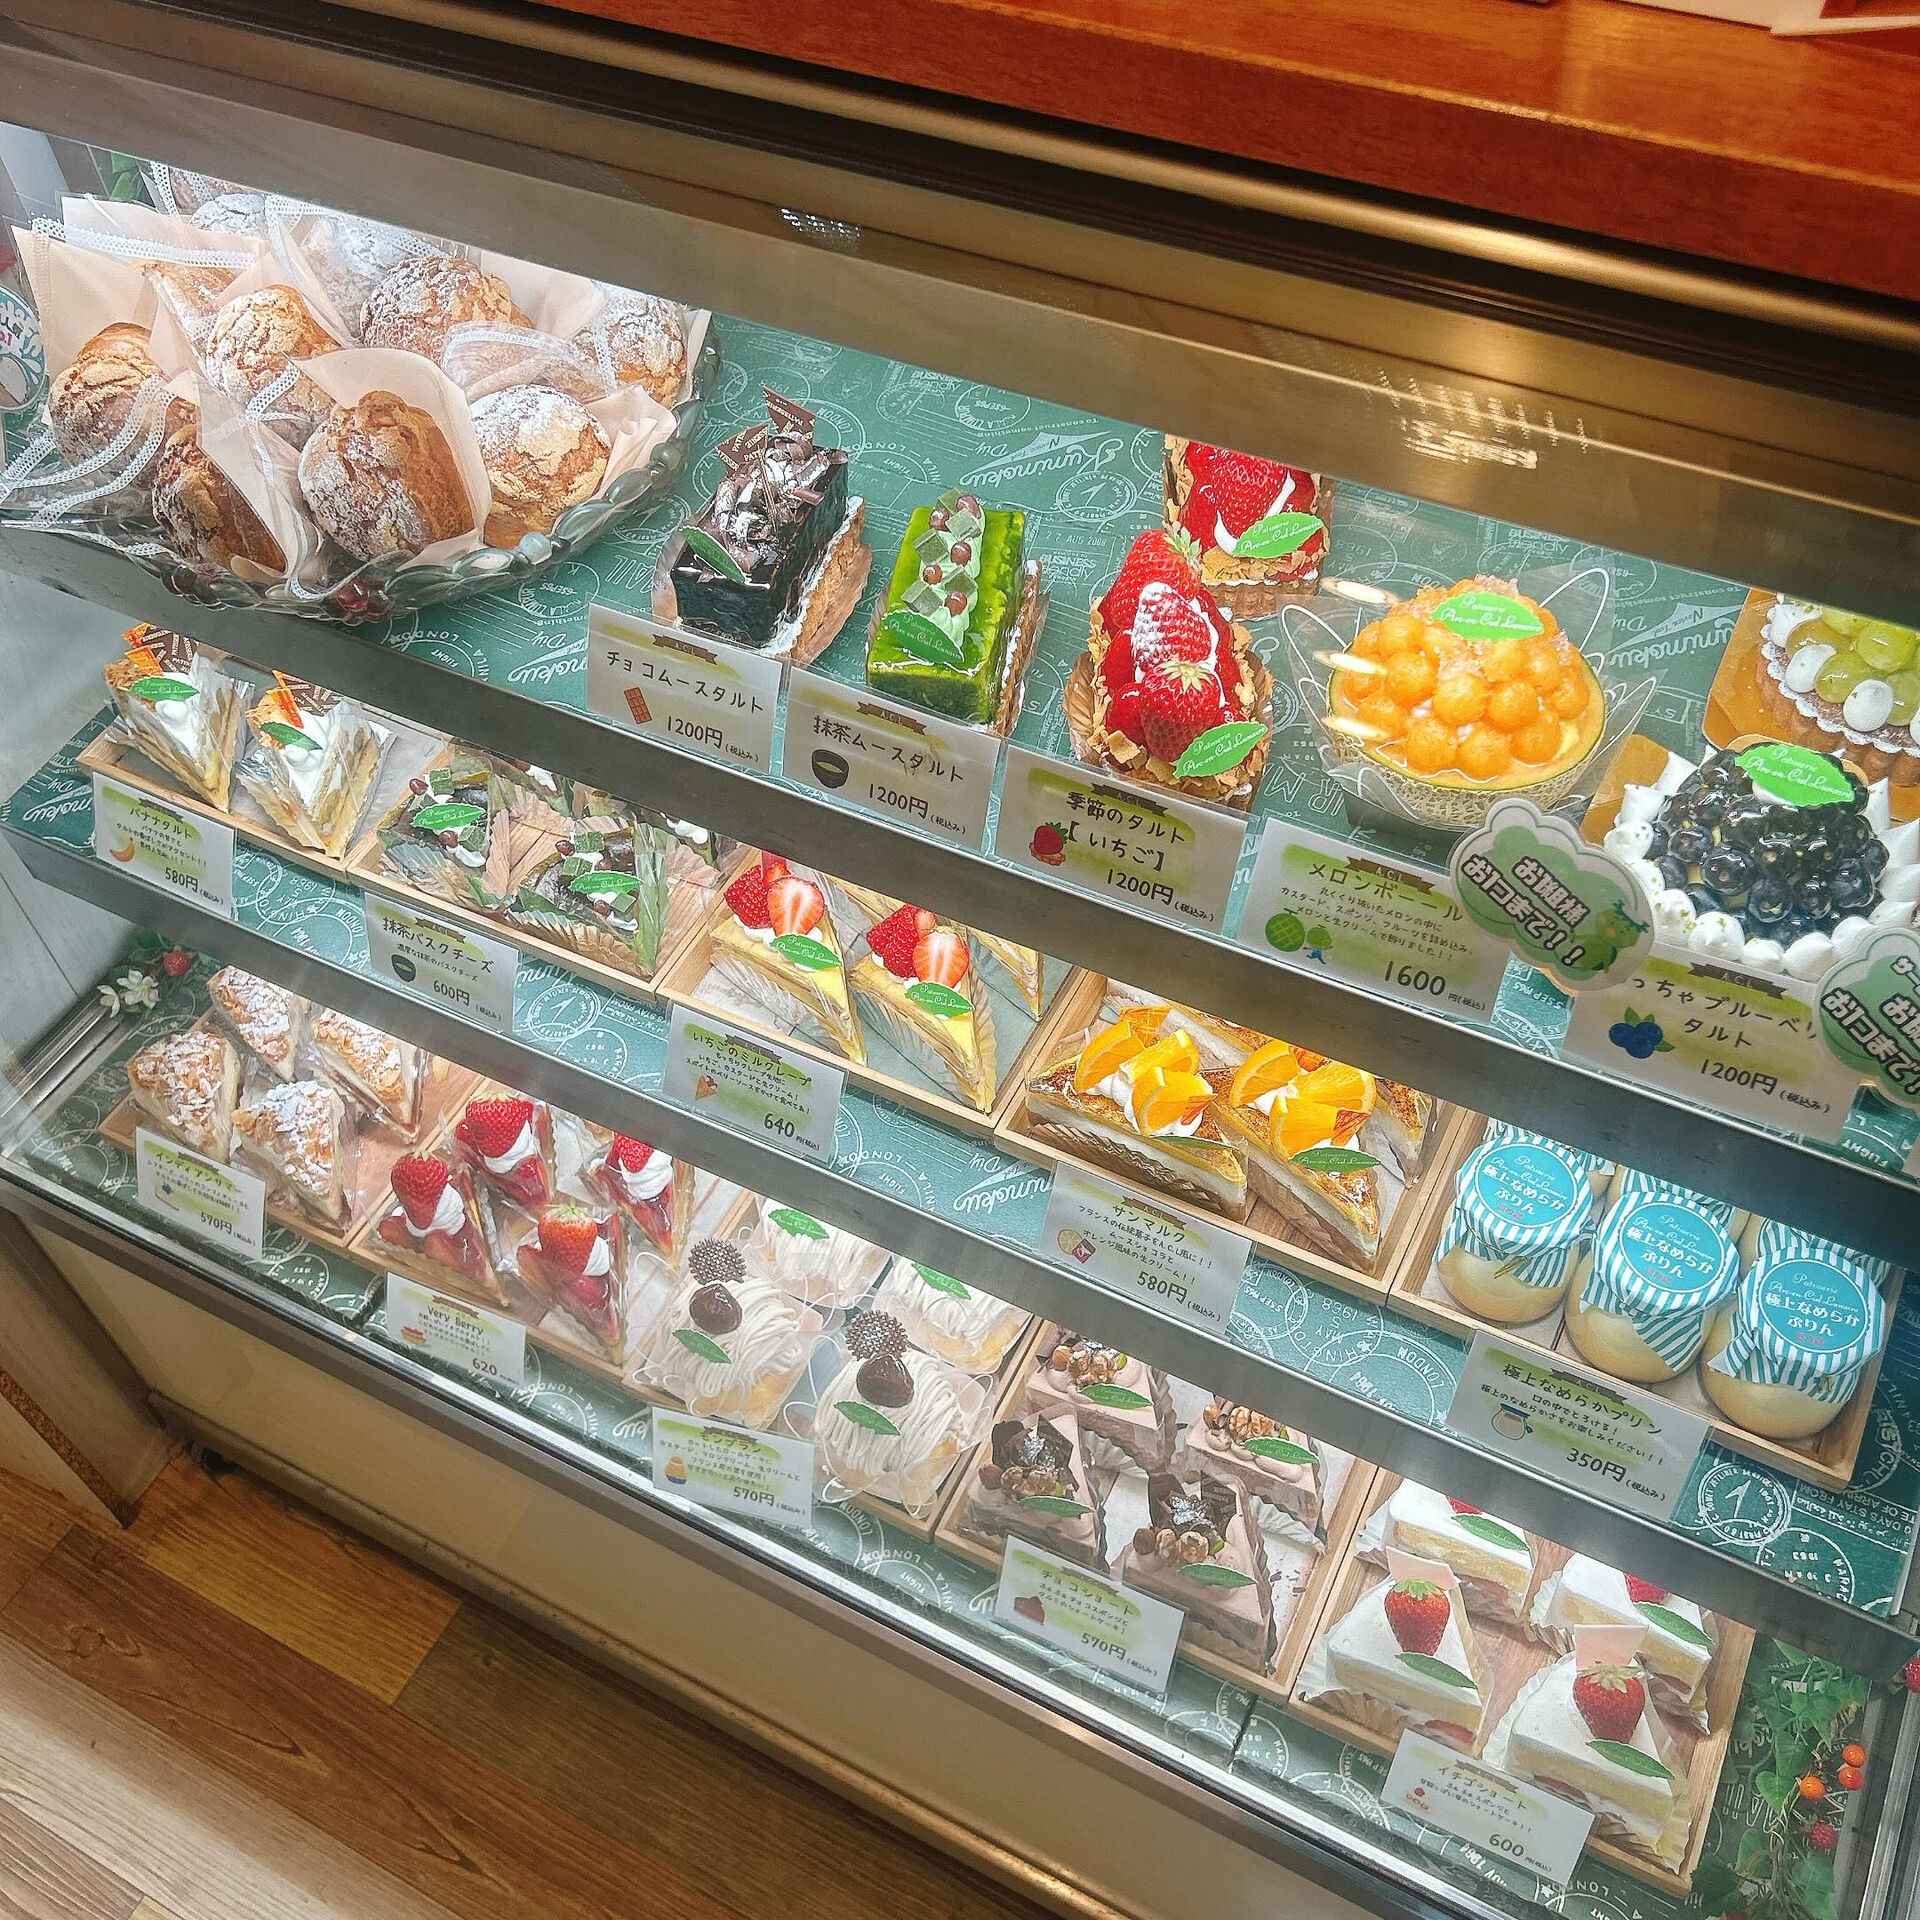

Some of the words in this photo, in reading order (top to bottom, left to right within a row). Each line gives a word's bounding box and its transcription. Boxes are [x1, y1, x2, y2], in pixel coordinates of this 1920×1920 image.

[975, 441, 1009, 457] Diy
[531, 630, 566, 649] Diy
[606, 649, 765, 715] チョコムースタルト
[812, 714, 964, 783] 抹茶ムースタルト
[130, 808, 192, 840] バナナタルト
[1066, 791, 1185, 844] 季節のタルト
[382, 917, 494, 974] 抹茶バスクチーズ
[1384, 960, 1447, 997] 1600
[1683, 1018, 1753, 1049] タルト
[693, 1032, 812, 1086] いちごのミルクレープ
[764, 1113, 796, 1138] 640
[968, 1153, 1001, 1173] Diy
[1112, 1205, 1186, 1243] サンマルク
[428, 1306, 451, 1323] Very
[455, 1317, 484, 1335] Berry
[472, 1357, 498, 1376] 620
[1502, 1363, 1664, 1435] 極上なめらかプリン
[701, 1431, 762, 1453] モンブラン
[1040, 1570, 1133, 1615] チョコショート
[1438, 1767, 1528, 1810] イチゴショート
[1489, 1833, 1525, 1857] 600
